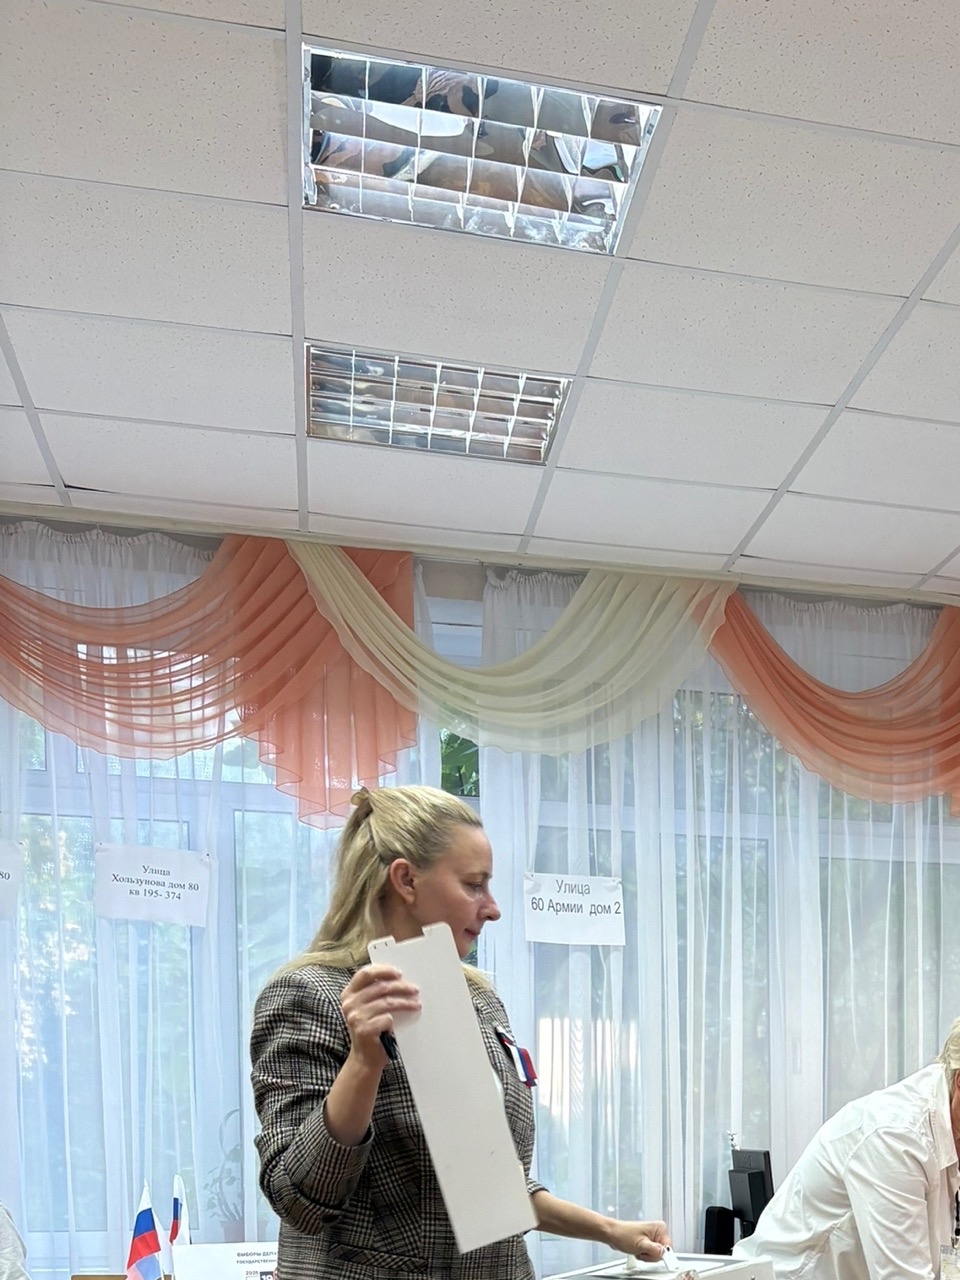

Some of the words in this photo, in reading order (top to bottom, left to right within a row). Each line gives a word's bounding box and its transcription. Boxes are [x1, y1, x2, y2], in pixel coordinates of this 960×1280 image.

[142, 864, 171, 877] Улица
[168, 881, 186, 890] дом
[188, 882, 199, 891] 80
[555, 879, 591, 897] Улица
[531, 896, 545, 911] 60
[547, 898, 583, 915] Армии
[589, 903, 612, 917] дом
[614, 901, 621, 914] 2
